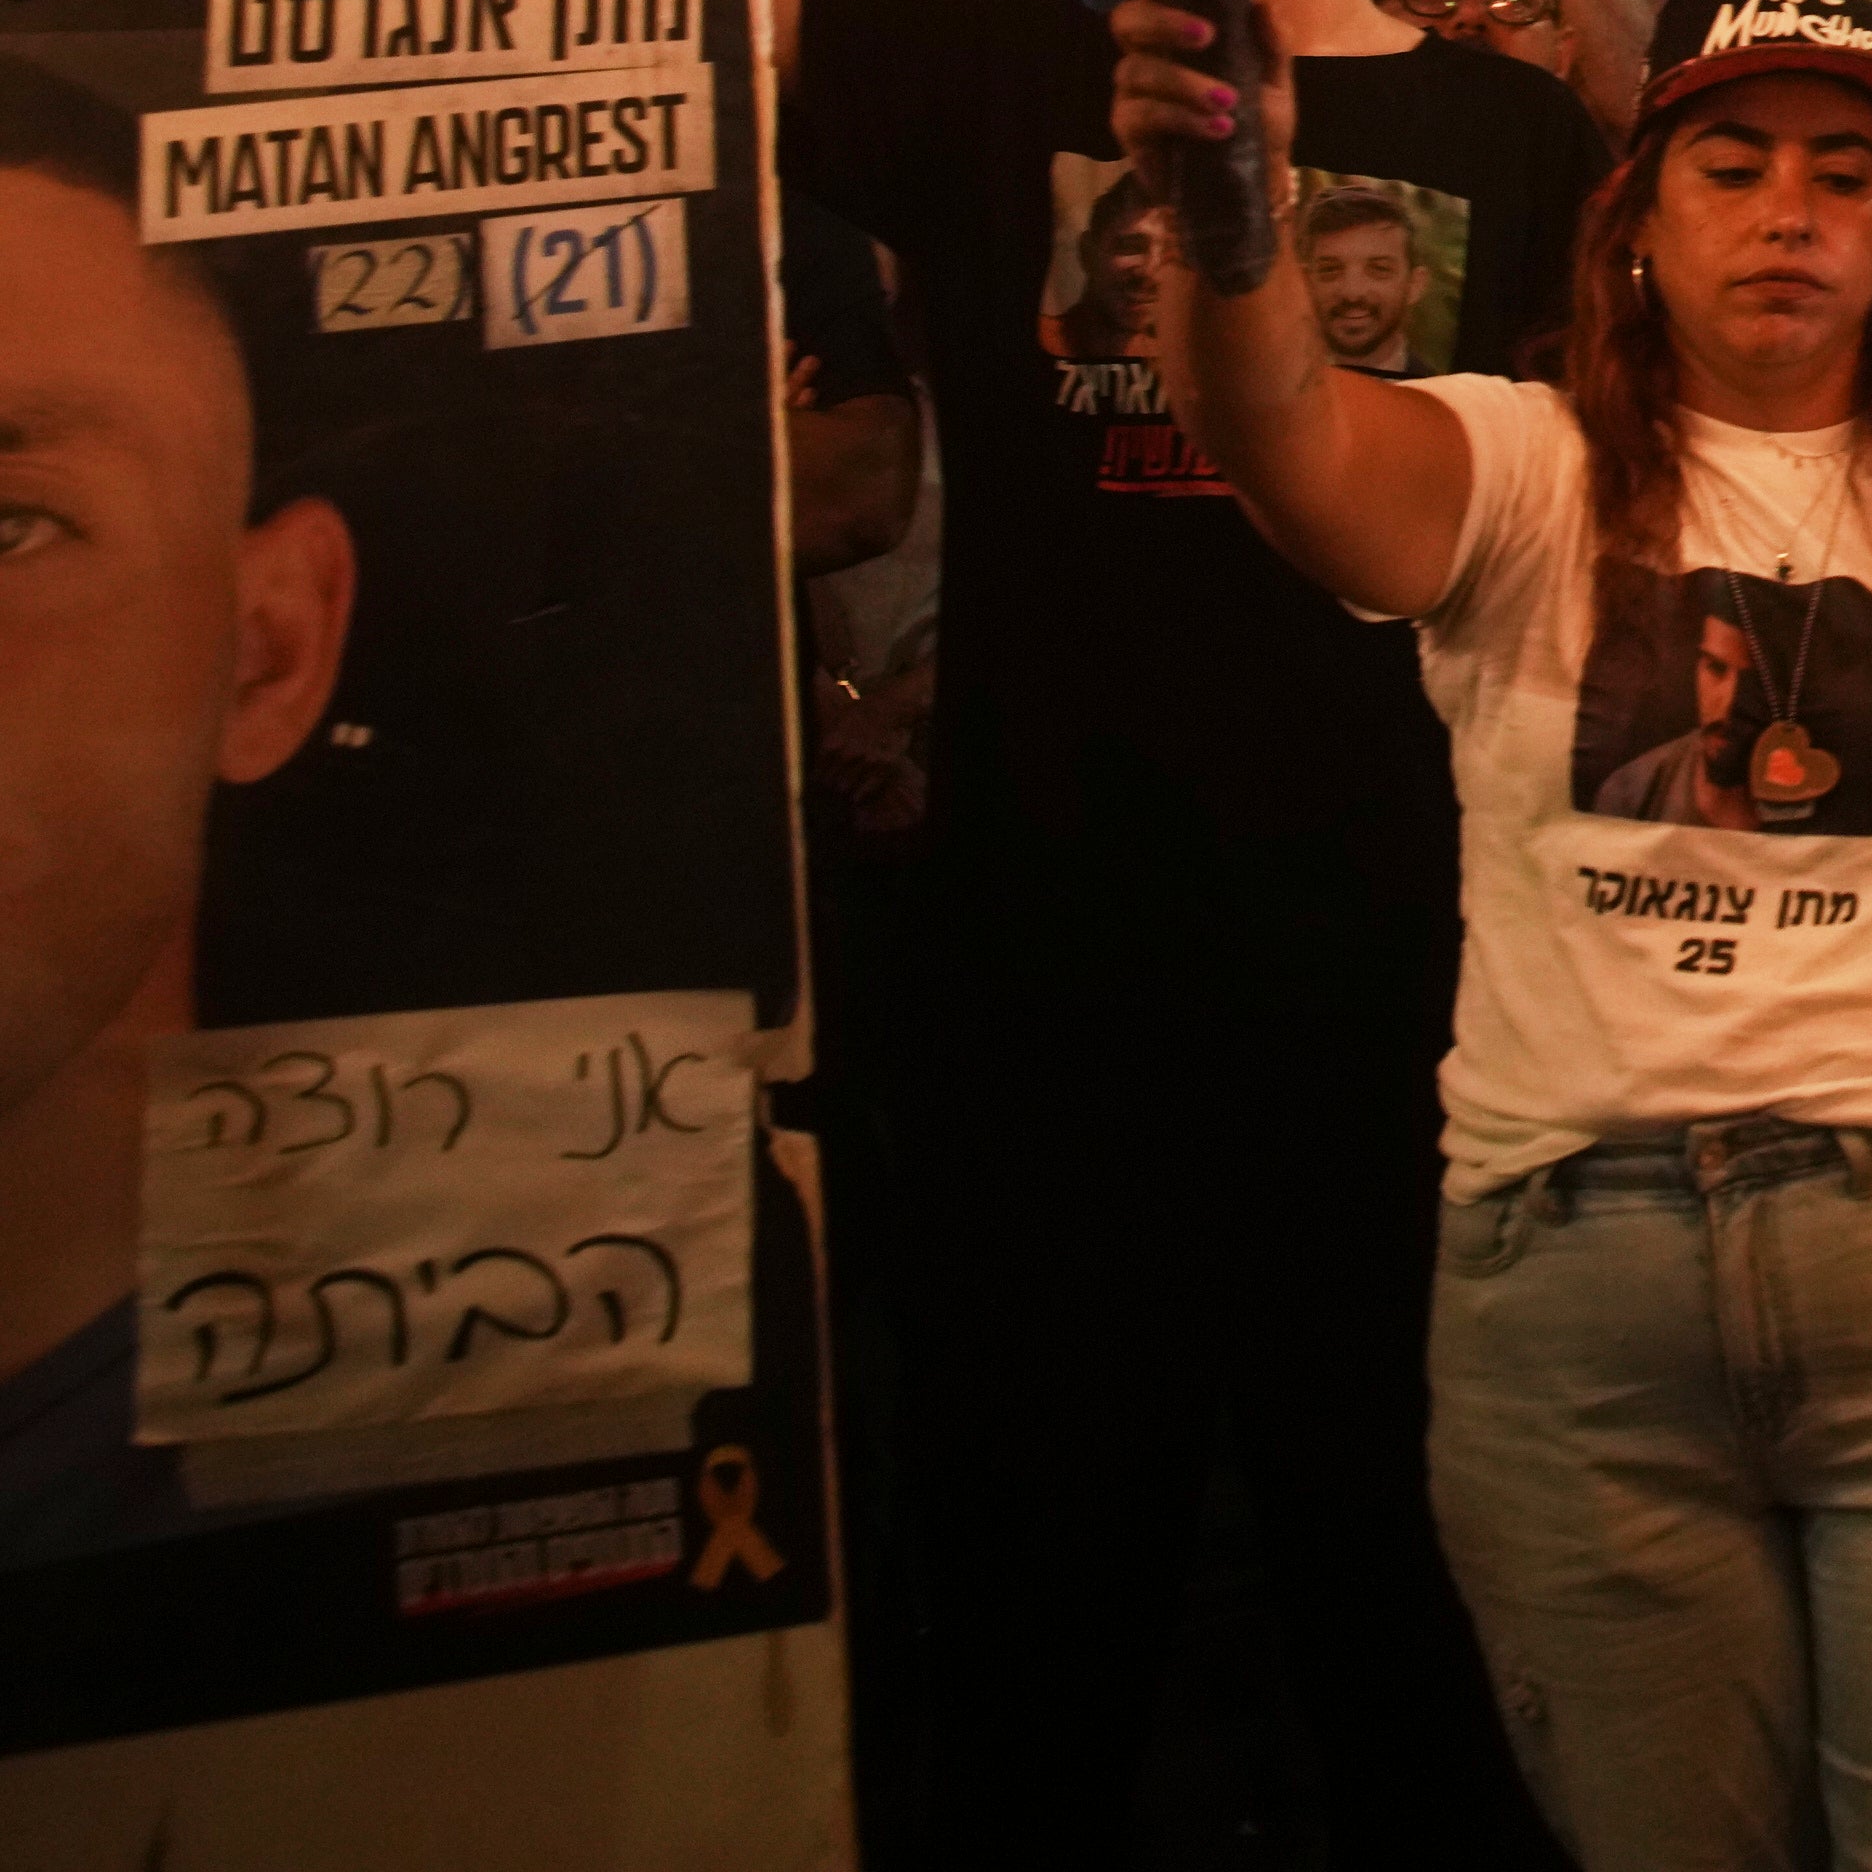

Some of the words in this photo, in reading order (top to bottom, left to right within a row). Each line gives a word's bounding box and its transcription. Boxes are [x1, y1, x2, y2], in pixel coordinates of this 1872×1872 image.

[164, 115, 386, 220] MATAN
[403, 92, 687, 197] ANGREST
[312, 235, 471, 324] (22)
[1578, 866, 1755, 926] צנגאוקר
[1774, 887, 1859, 930] מתן
[1674, 937, 1738, 976] 25
[187, 1050, 473, 1156] רוצה
[561, 1031, 705, 1160] אני
[163, 1232, 682, 1406] הביתה
